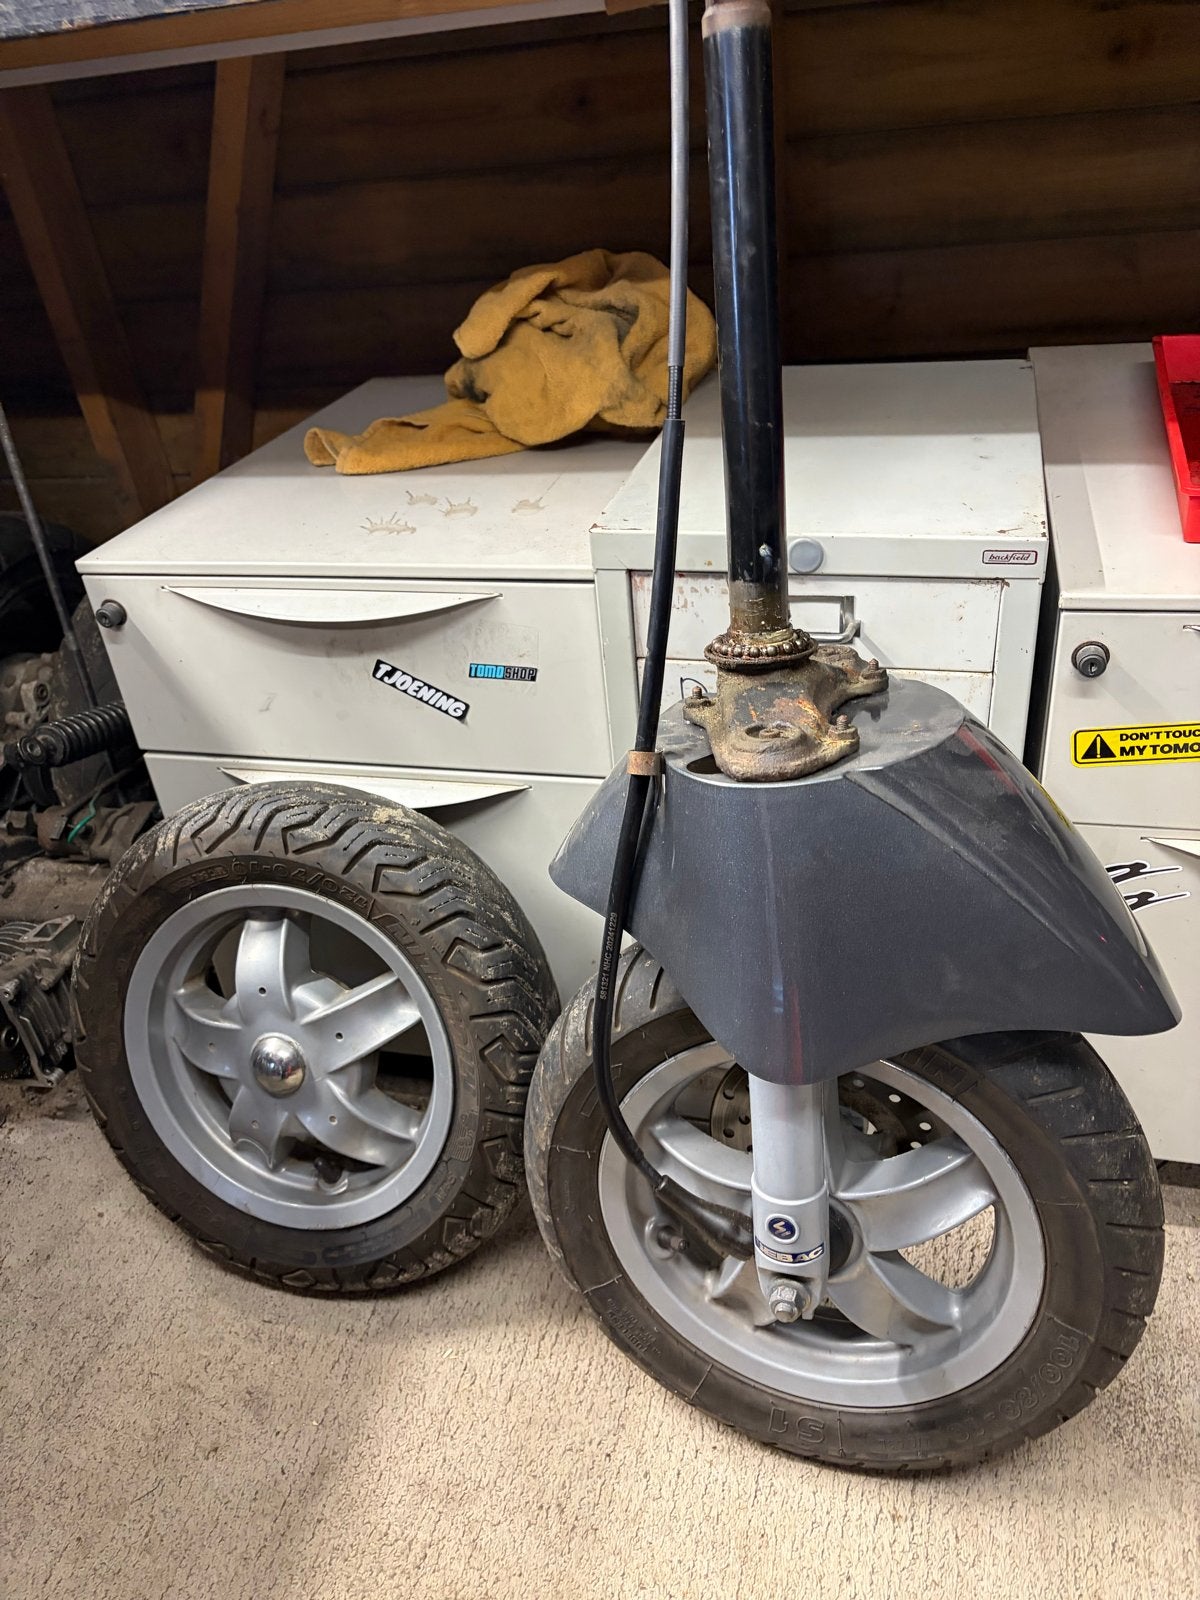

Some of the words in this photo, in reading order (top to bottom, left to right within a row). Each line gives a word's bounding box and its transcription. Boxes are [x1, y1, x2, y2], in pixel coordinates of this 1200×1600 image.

[988, 553, 1031, 562] backfield
[470, 664, 536, 681] TOMOSHOP
[375, 663, 466, 718] TJOENING
[1120, 731, 1161, 742] DON'T
[1120, 745, 1147, 757] MY
[1150, 742, 1200, 755] TOMO
[767, 1407, 826, 1444] S1
